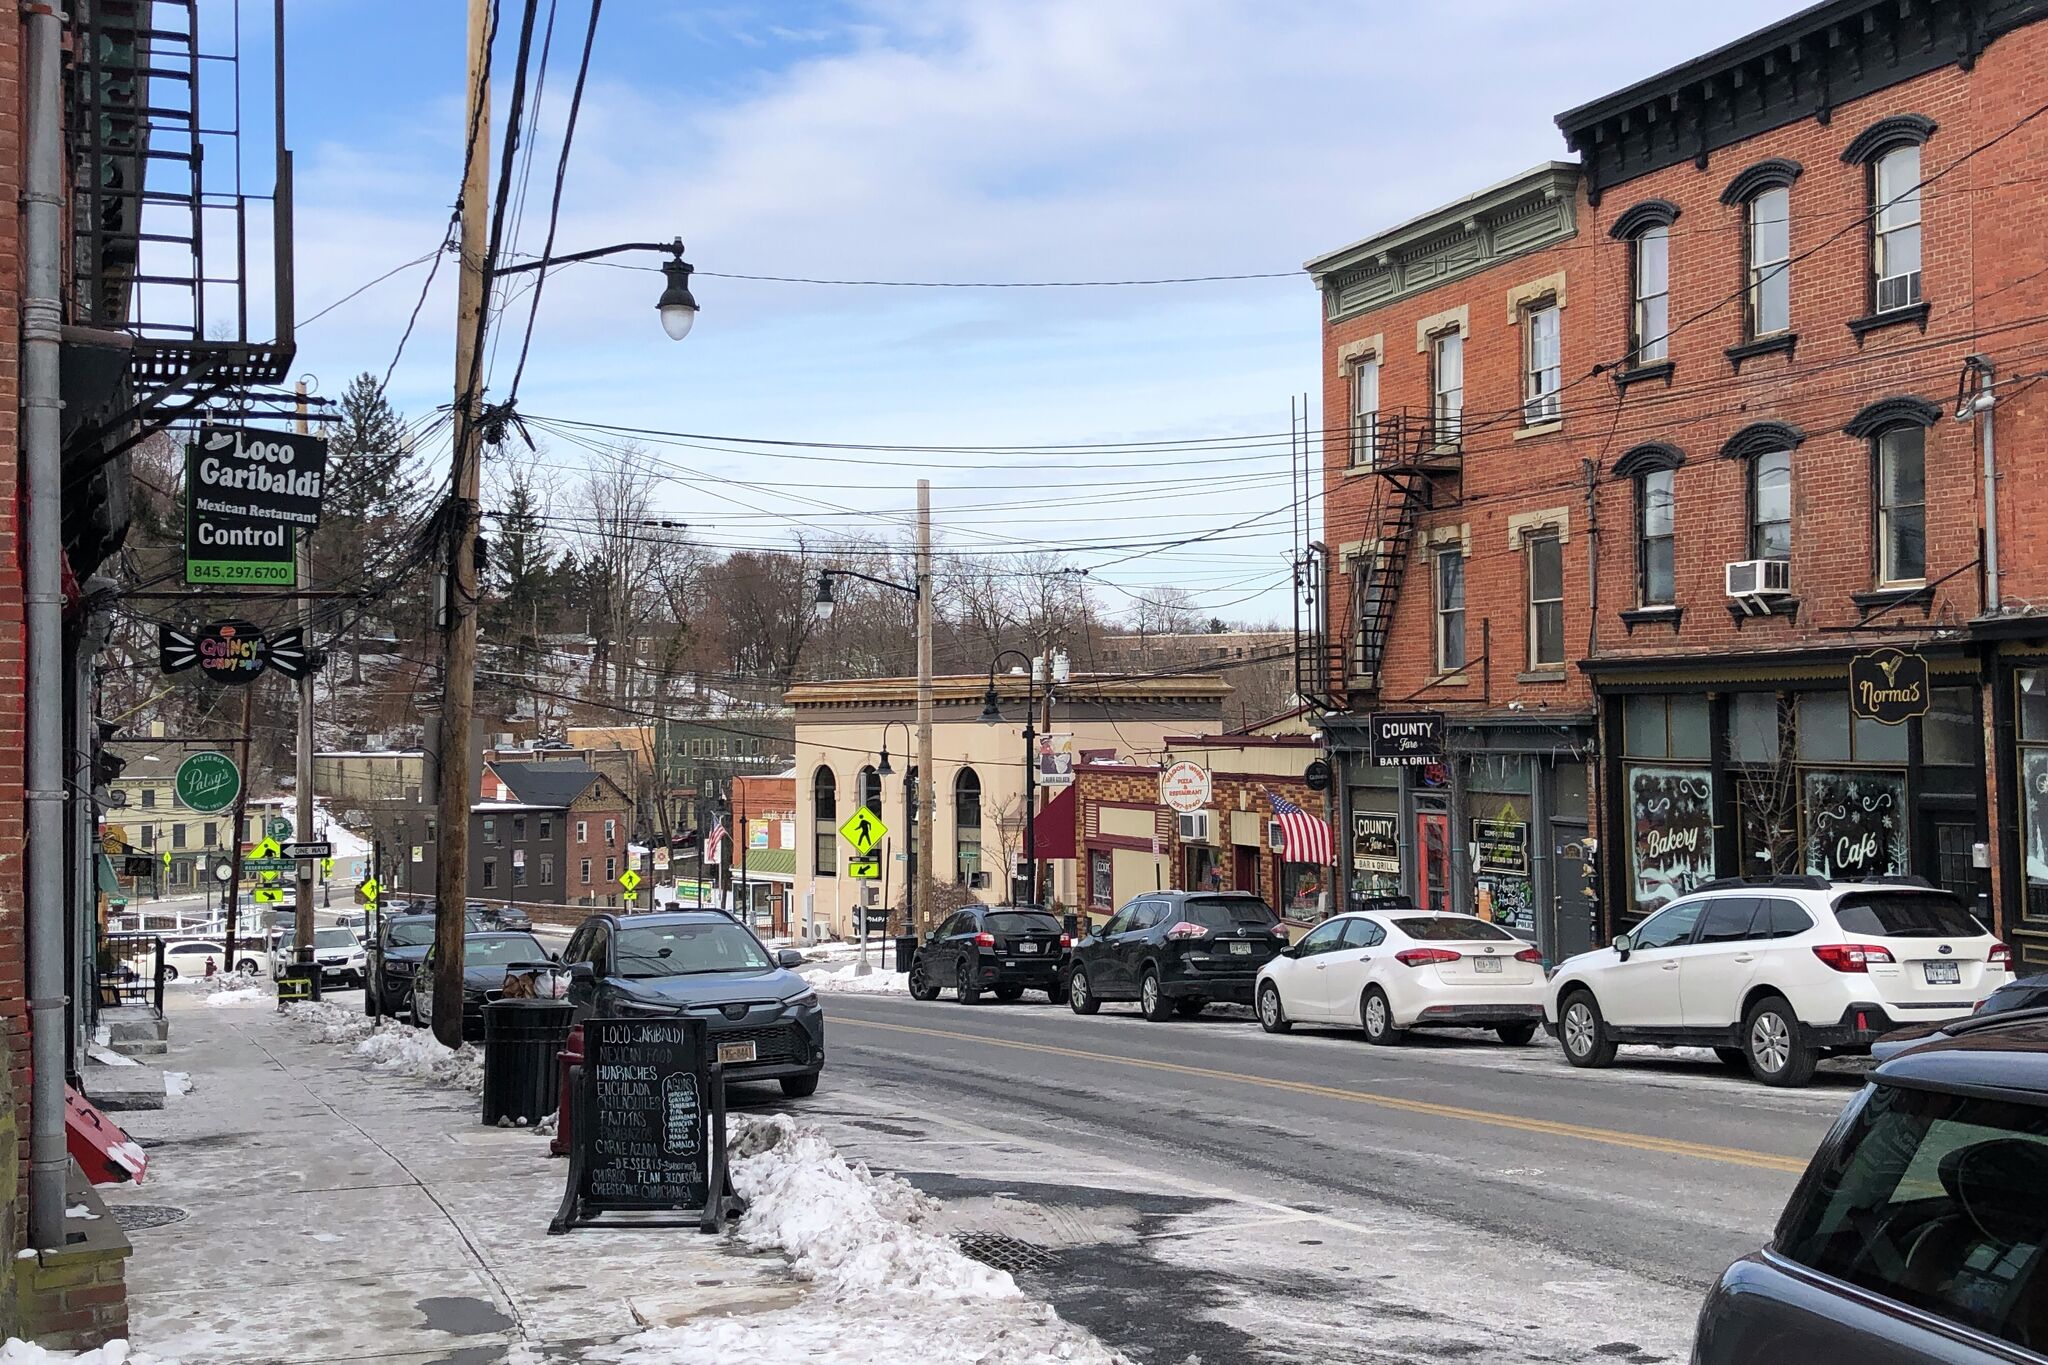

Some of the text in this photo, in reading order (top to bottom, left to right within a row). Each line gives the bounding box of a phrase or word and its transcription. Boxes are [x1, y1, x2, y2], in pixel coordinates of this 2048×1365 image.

[233, 431, 295, 464] Loco
[200, 457, 321, 498] Garibaldi
[196, 498, 317, 524] Mexican Restaurant
[198, 522, 284, 547] Control
[193, 566, 288, 580] 845.297.6700
[1859, 680, 1920, 712] Norma's
[1382, 722, 1433, 739] COUNTY
[1398, 737, 1418, 751] Fare
[1380, 757, 1399, 766] BAR
[1409, 756, 1438, 766] GRILL
[184, 768, 231, 797] Patsy's
[1165, 765, 1185, 783] WAGON
[1358, 819, 1393, 838] COUNTY
[1369, 837, 1383, 851] Fare
[1647, 827, 1698, 858] Bakery
[1836, 831, 1878, 869] Café
[1360, 860, 1371, 868] BAR
[1376, 861, 1394, 871] GRILL
[602, 1025, 631, 1044] LOCO
[600, 1046, 673, 1064] MEXICAN FOOD
[596, 1064, 658, 1081] HUARACHES
[597, 1081, 651, 1096] ENCHILADA
[596, 1095, 661, 1110] CHILAQUILES
[600, 1110, 647, 1127] FAJITAS
[595, 1139, 628, 1155] CARNE
[667, 1140, 695, 1150] JAMAICA
[592, 1168, 627, 1183] CHURROS
[636, 1170, 661, 1184] FLAN
[591, 1182, 640, 1197] CHEESECAKE
